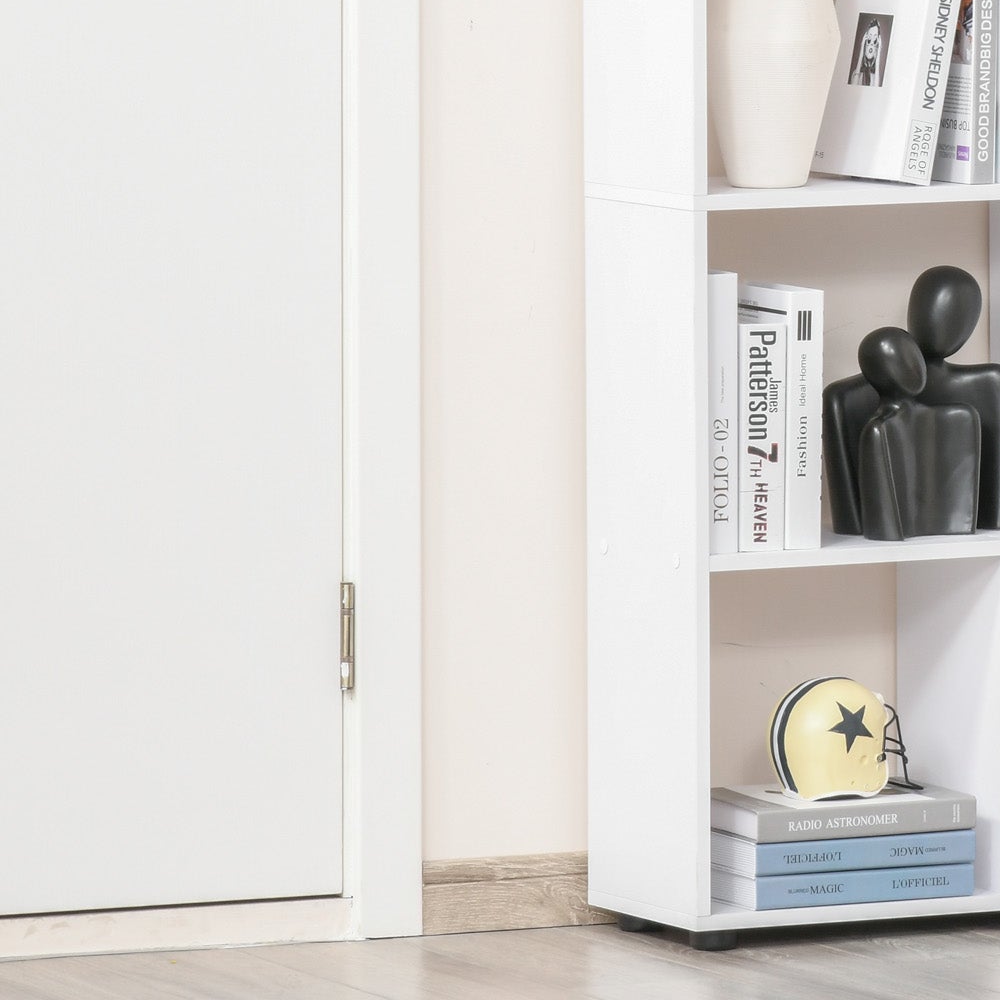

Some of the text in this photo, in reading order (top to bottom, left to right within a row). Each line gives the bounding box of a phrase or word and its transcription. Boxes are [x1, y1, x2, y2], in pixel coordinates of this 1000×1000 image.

[922, 44, 944, 110] SHELDON
[908, 126, 922, 170] ANGELS
[917, 160, 927, 176] OF
[748, 330, 777, 440] Patterson
[769, 378, 782, 414] James
[713, 417, 729, 441] 02
[797, 353, 808, 478] Fashion Ideal Home
[713, 456, 729, 524] FOLIO
[753, 482, 768, 544] HEAVEN
[788, 813, 898, 832] RADIO ASTRONOMER
[889, 845, 924, 857] MAGIC
[810, 883, 844, 895] MAGIC
